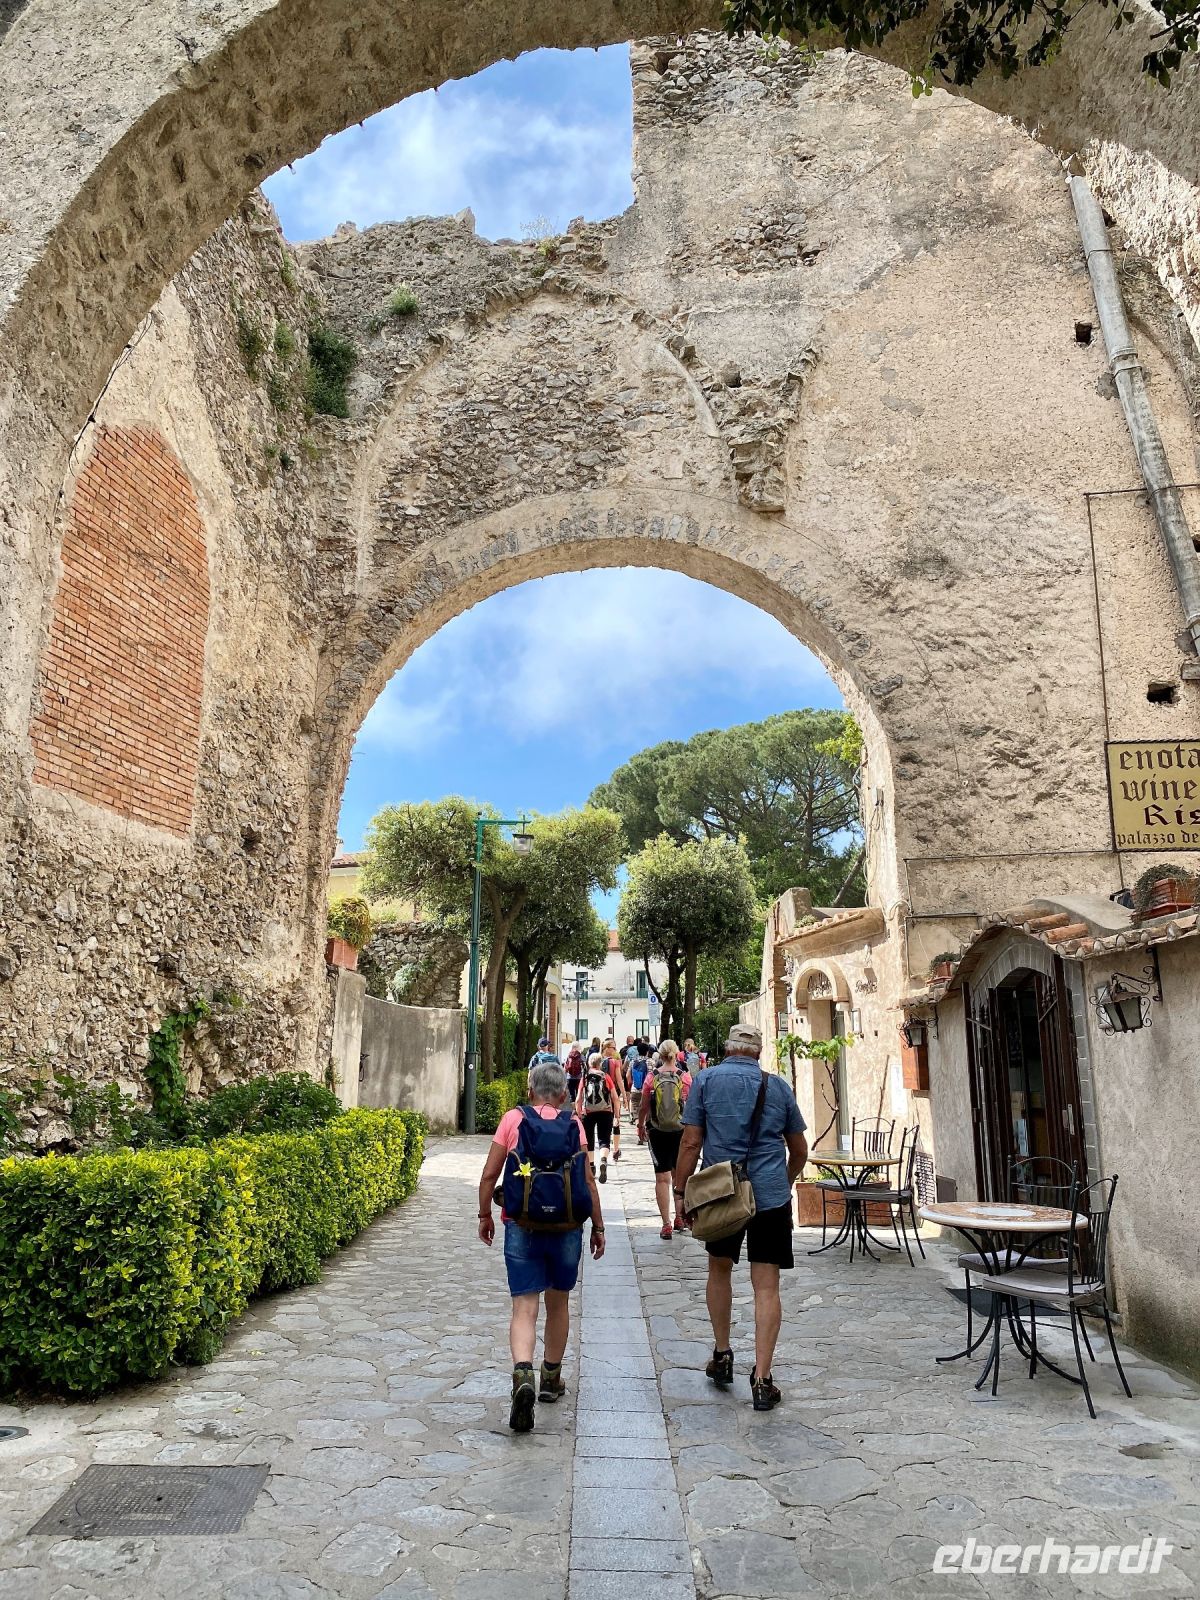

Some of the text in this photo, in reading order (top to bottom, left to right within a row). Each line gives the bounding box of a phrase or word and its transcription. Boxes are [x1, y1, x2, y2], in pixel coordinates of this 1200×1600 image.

[1119, 743, 1200, 770] enota
[1120, 773, 1199, 801] wine
[1144, 804, 1200, 826] Ris
[1117, 830, 1199, 848] palazzo de
